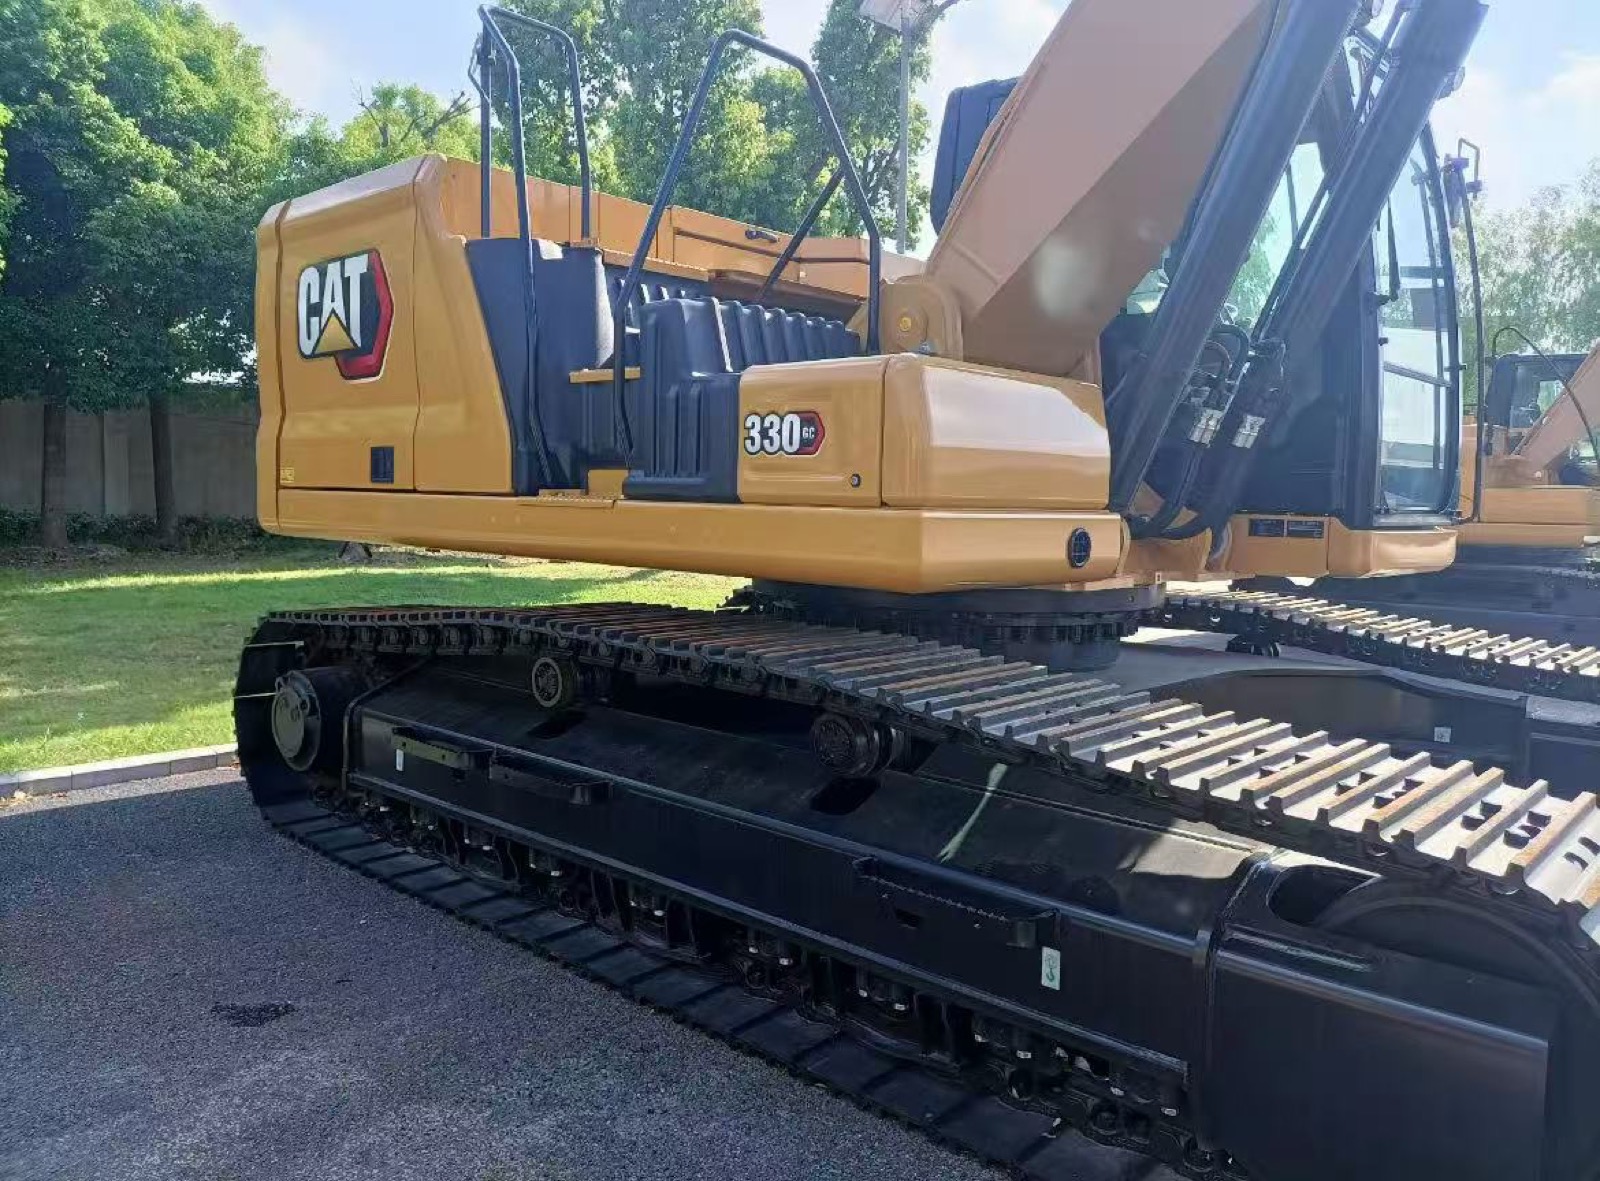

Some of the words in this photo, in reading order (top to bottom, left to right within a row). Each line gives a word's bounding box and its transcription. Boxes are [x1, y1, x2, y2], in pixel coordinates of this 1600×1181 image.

[299, 254, 368, 355] CAT
[745, 413, 800, 453] 330
[802, 427, 815, 438] GC
